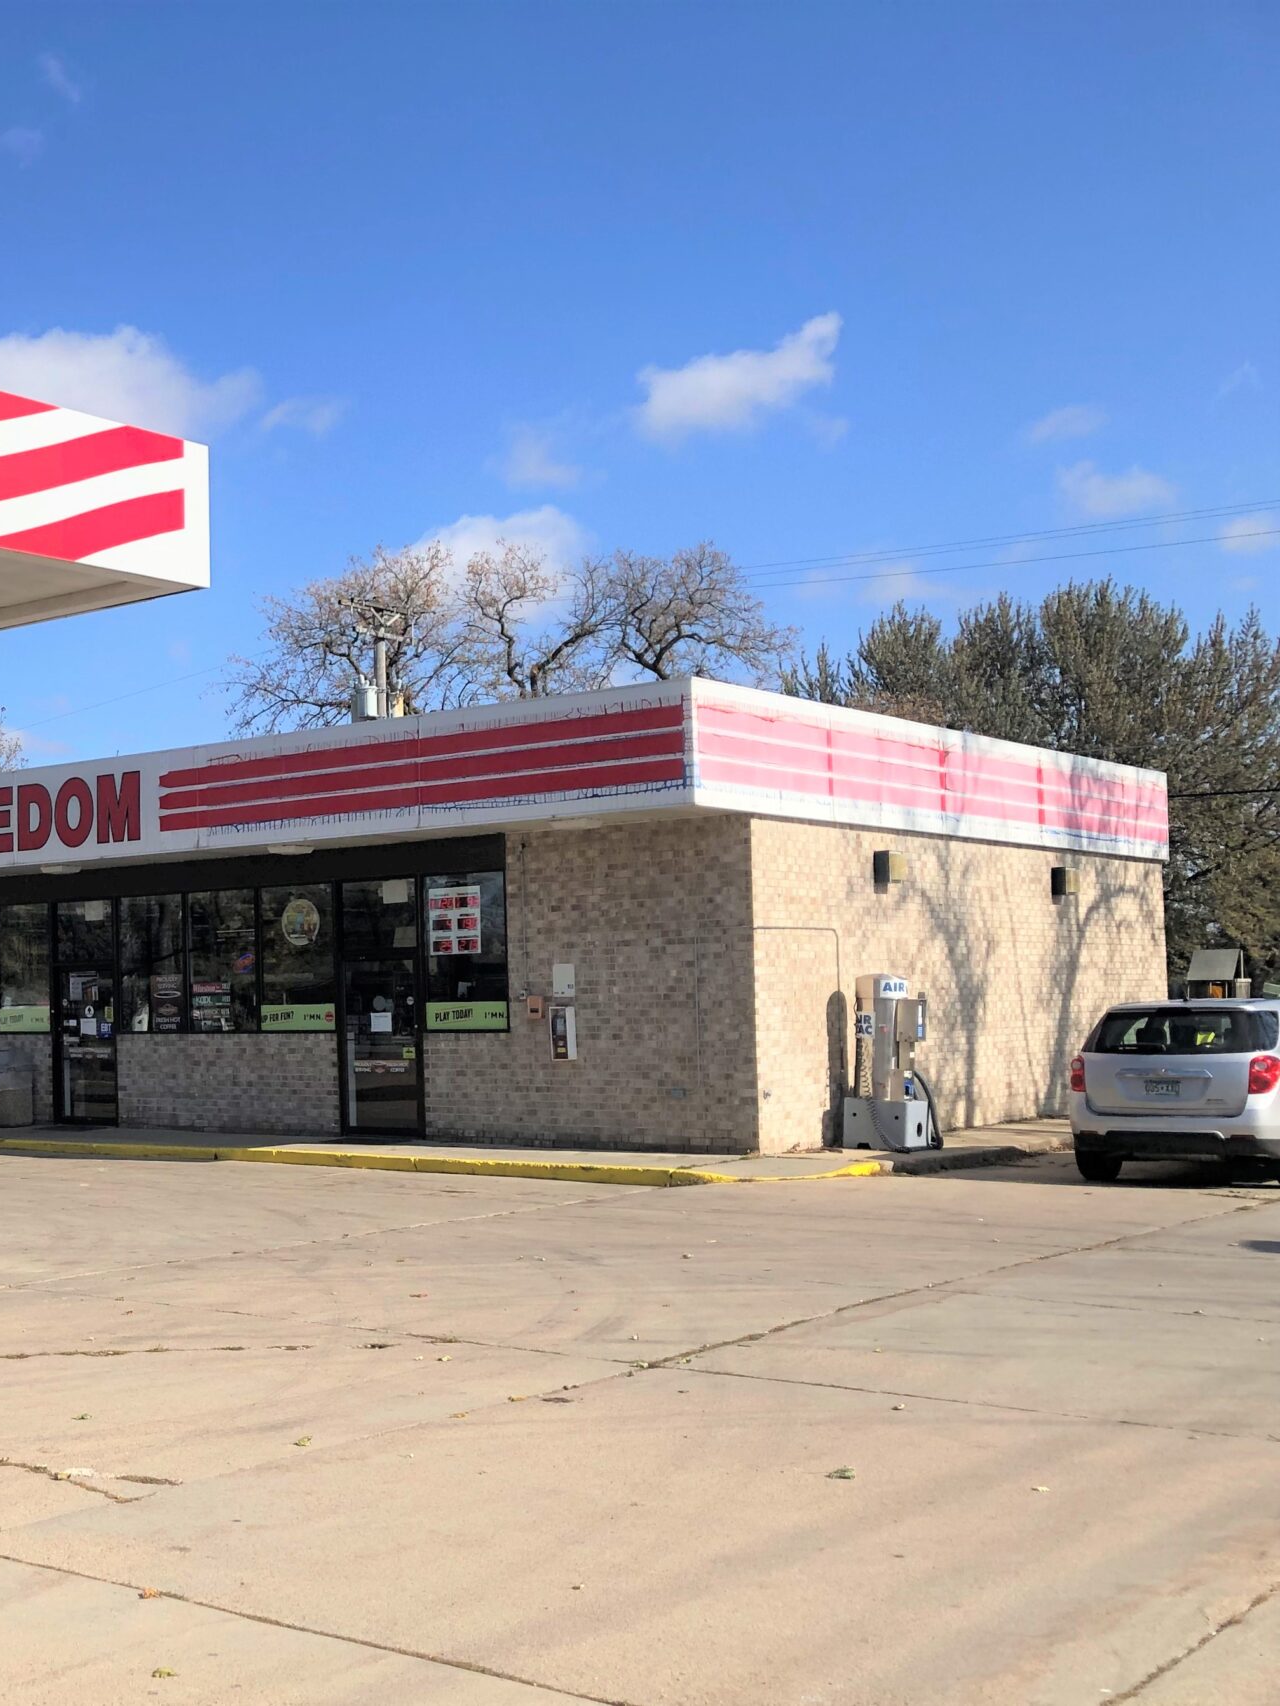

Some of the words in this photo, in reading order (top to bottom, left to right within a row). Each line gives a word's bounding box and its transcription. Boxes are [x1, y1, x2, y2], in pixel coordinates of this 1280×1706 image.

[883, 982, 906, 992] AIR
[269, 1012, 279, 1022] FOR
[280, 1010, 294, 1021] FUN?
[435, 1012, 450, 1022] PLAY
[452, 1008, 473, 1020] TODAY!
[856, 1024, 873, 1035] AC
